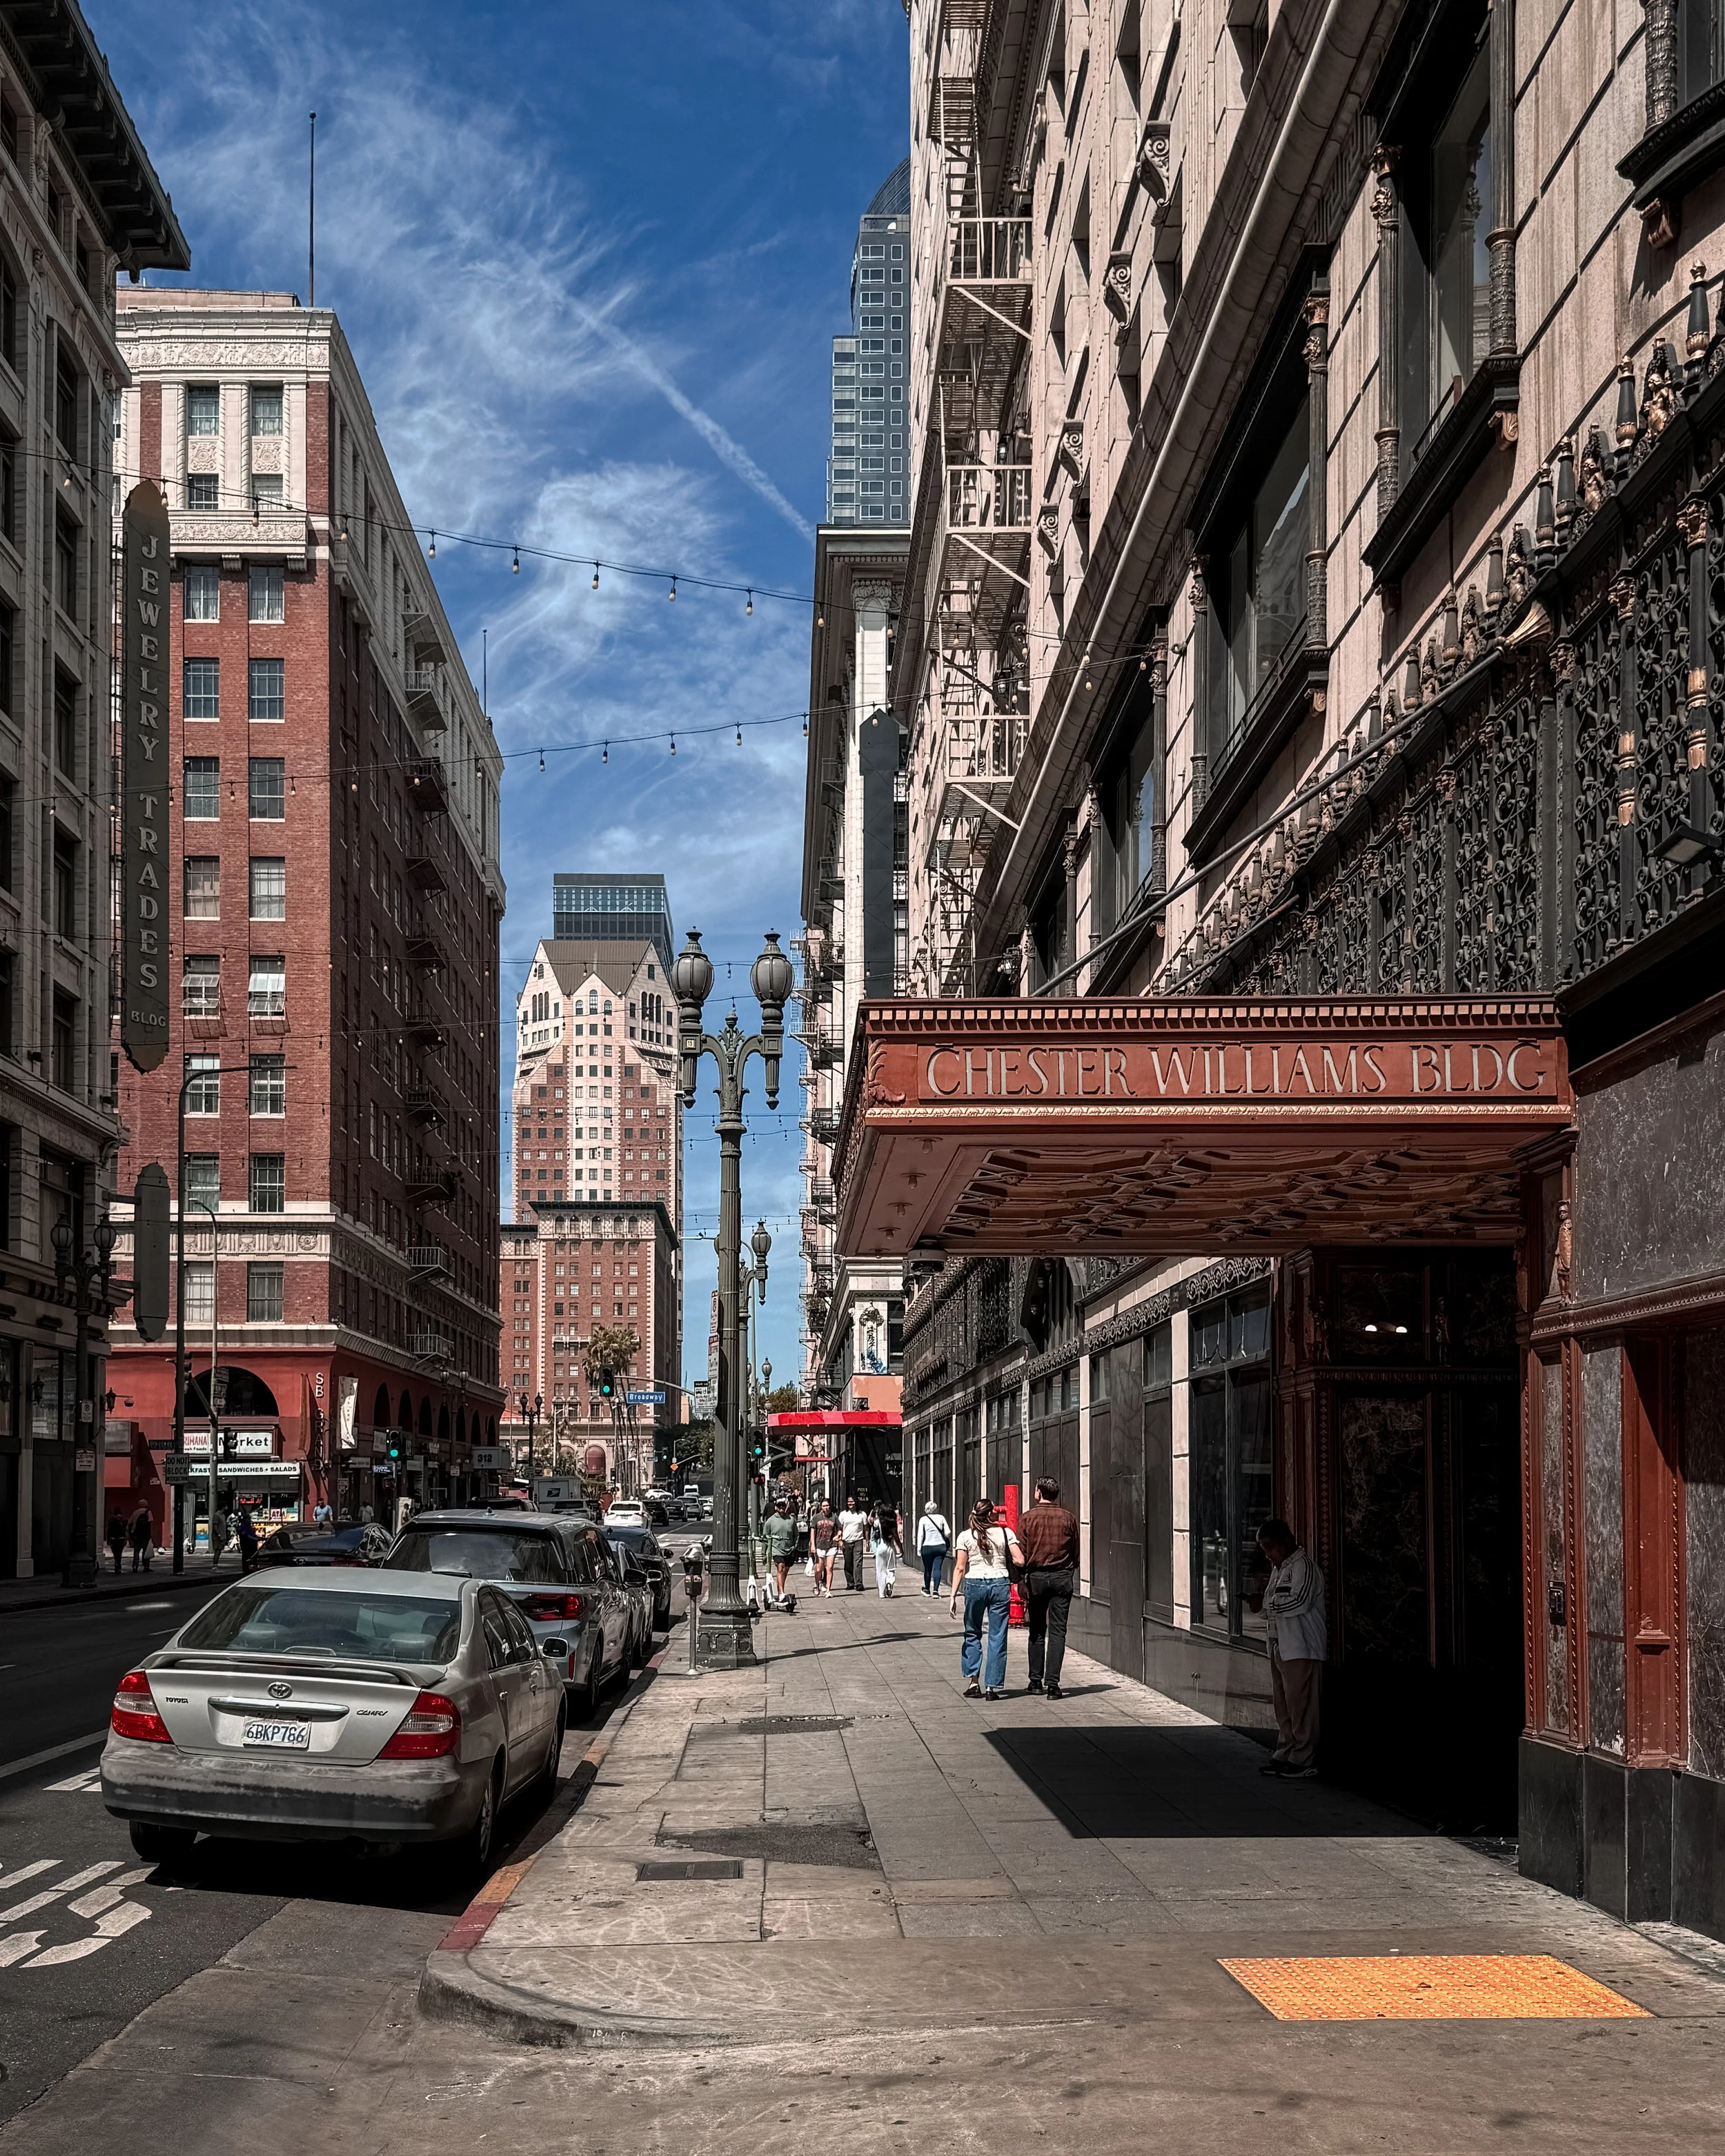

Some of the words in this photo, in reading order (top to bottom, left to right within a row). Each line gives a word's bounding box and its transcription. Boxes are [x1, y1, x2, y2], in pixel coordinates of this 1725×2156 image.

[138, 535, 161, 761] JEWELRY
[138, 793, 159, 988] TRADES
[131, 1011, 166, 1027] BLDG
[927, 1045, 1136, 1097] CHESTER
[1151, 1045, 1387, 1096] WILLIAMS
[1410, 1040, 1547, 1094] BLDG
[315, 1372, 324, 1398] SB
[184, 1436, 207, 1445] RIMANA
[218, 1436, 268, 1446] Mrket
[477, 1454, 493, 1463] 312
[165, 1696, 188, 1704] TOYOTA
